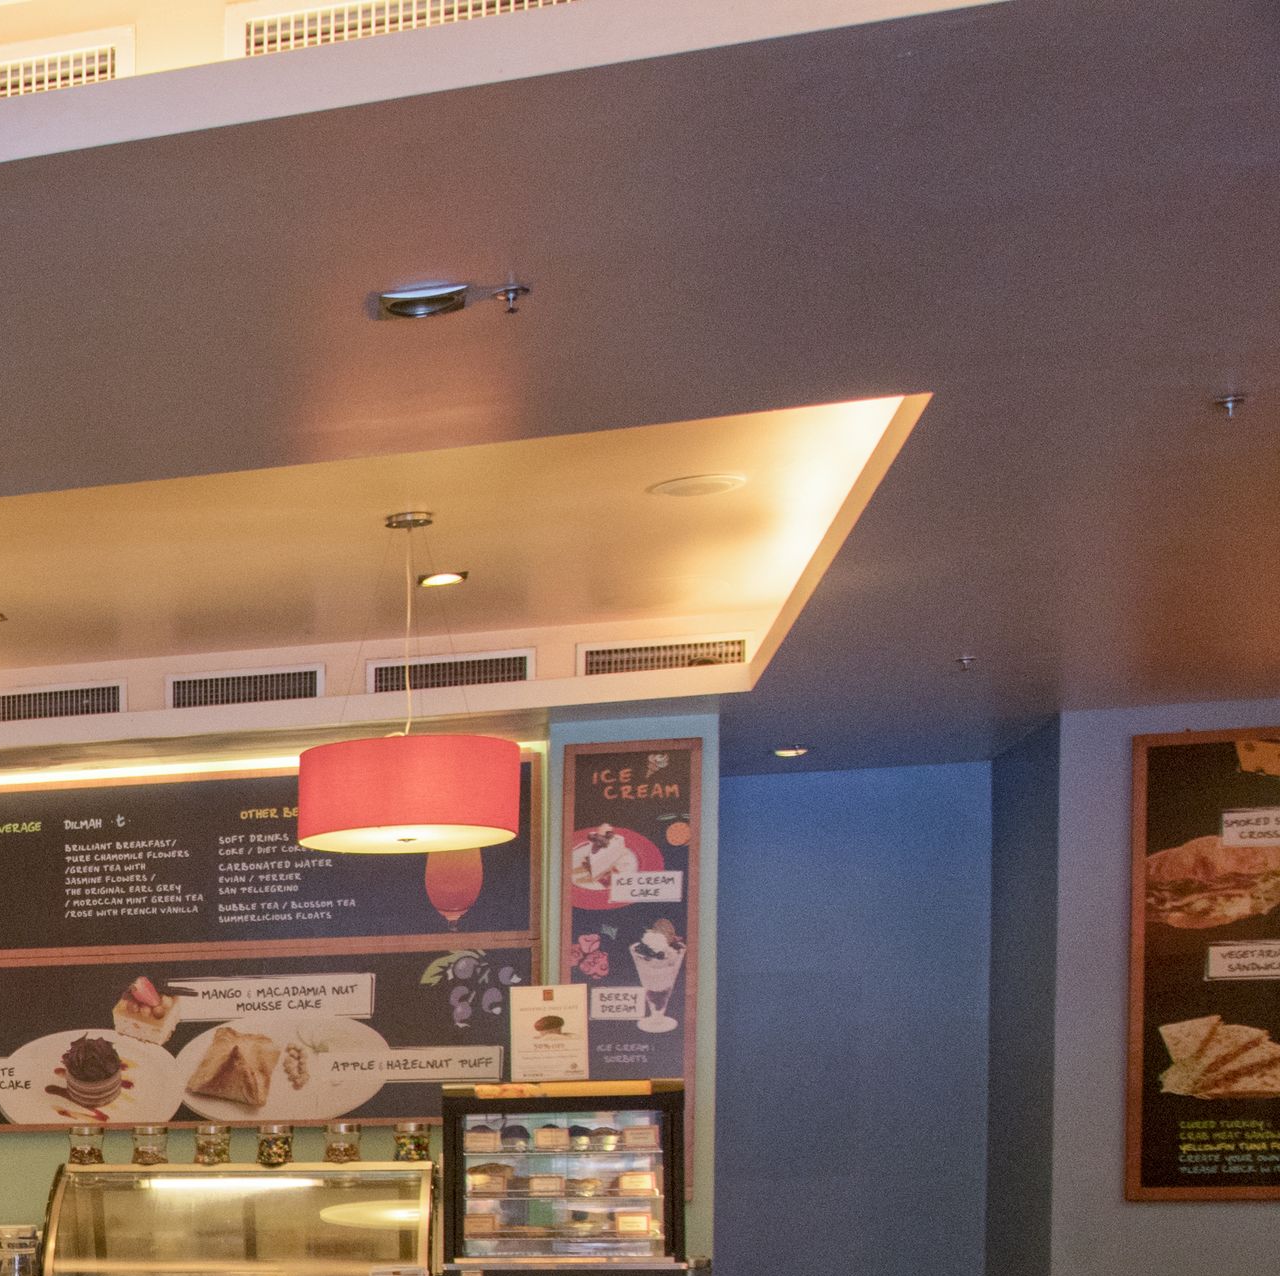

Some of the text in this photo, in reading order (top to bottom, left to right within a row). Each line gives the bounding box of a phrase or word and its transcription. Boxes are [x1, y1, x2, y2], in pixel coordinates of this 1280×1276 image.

[592, 768, 632, 784] ICE
[604, 783, 680, 800] CREAM
[240, 808, 279, 819] OTHER
[63, 819, 102, 830] DILMAH
[1224, 817, 1269, 827] SMOKED
[219, 833, 289, 844] SOFT DRINKS
[65, 843, 112, 852] BRILLIANT
[219, 848, 244, 856] COKE
[257, 846, 277, 854] DIET
[65, 850, 189, 863] PURE CHAMOMILE FLOWERS
[219, 859, 332, 871] CARBONATED WATER
[65, 874, 148, 885] JASMINE FLOWERS
[259, 873, 301, 881] PERRIER
[637, 877, 674, 885] CREAM
[85, 886, 126, 895] ORIGINAL
[156, 884, 181, 893] GREY
[219, 885, 299, 895] SAN PELLEGRINO
[630, 889, 660, 897] CAKE
[73, 898, 123, 906] MOROCCAN
[126, 896, 148, 904] MINT
[151, 895, 181, 903] GREEN
[219, 899, 356, 912] BUBBLE TEA BLOSSOM TEA
[96, 908, 118, 916] WITH
[121, 907, 157, 916] FRENCH
[160, 905, 198, 914] VANILLA
[219, 912, 332, 923] SUMMERLICIOUS FLOATS
[202, 984, 358, 1000] MANGO MACADAMIA NUT
[600, 993, 637, 1004] BERRY
[237, 1000, 322, 1012] MOUSSE CAKE
[601, 1005, 636, 1013] DREAM
[331, 1057, 493, 1072] APPLE HAZELNUT PUFF
[0, 1080, 32, 1090] CAKE
